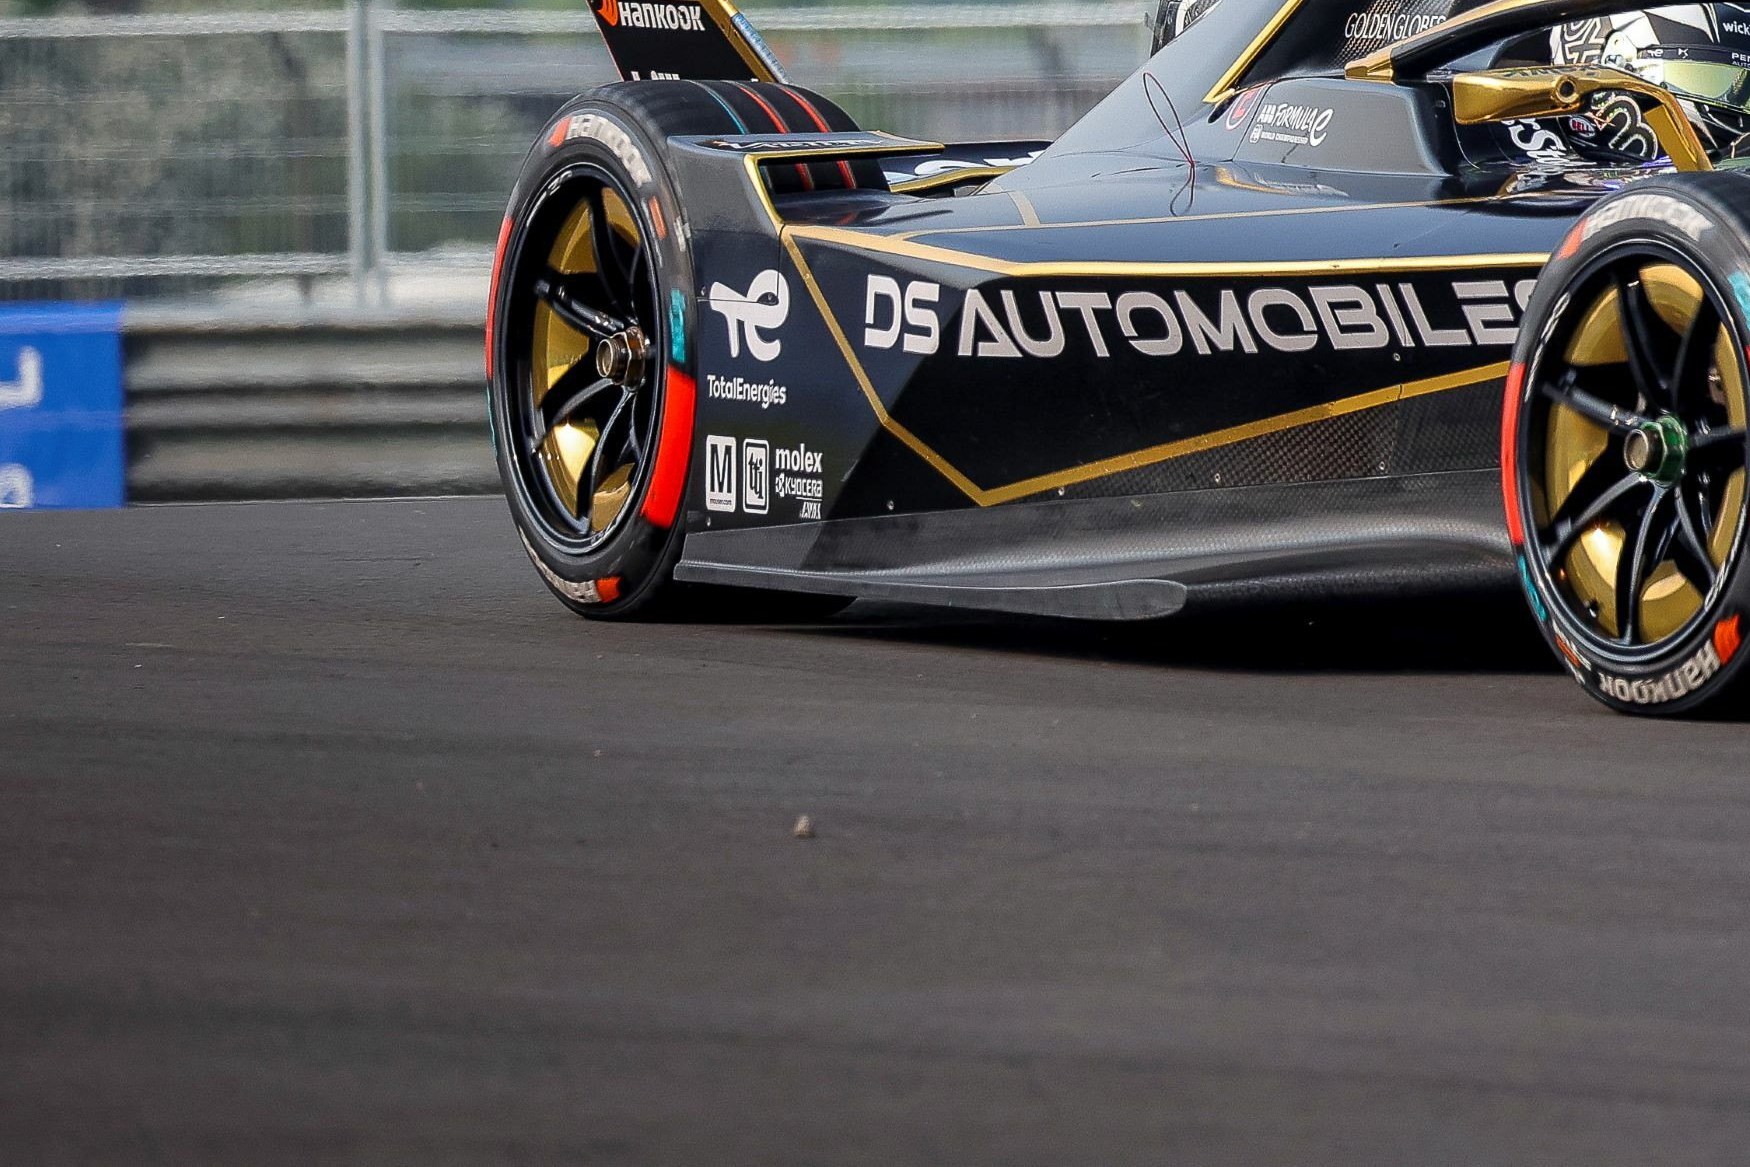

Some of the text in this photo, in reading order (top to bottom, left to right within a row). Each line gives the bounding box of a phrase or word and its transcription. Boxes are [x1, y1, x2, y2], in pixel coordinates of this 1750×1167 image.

[1345, 12, 1394, 41] GOLDEN
[864, 274, 941, 355] DS
[707, 374, 787, 409] TotalEnergies
[775, 442, 823, 473] molex
[785, 475, 823, 498] KYOCERA
